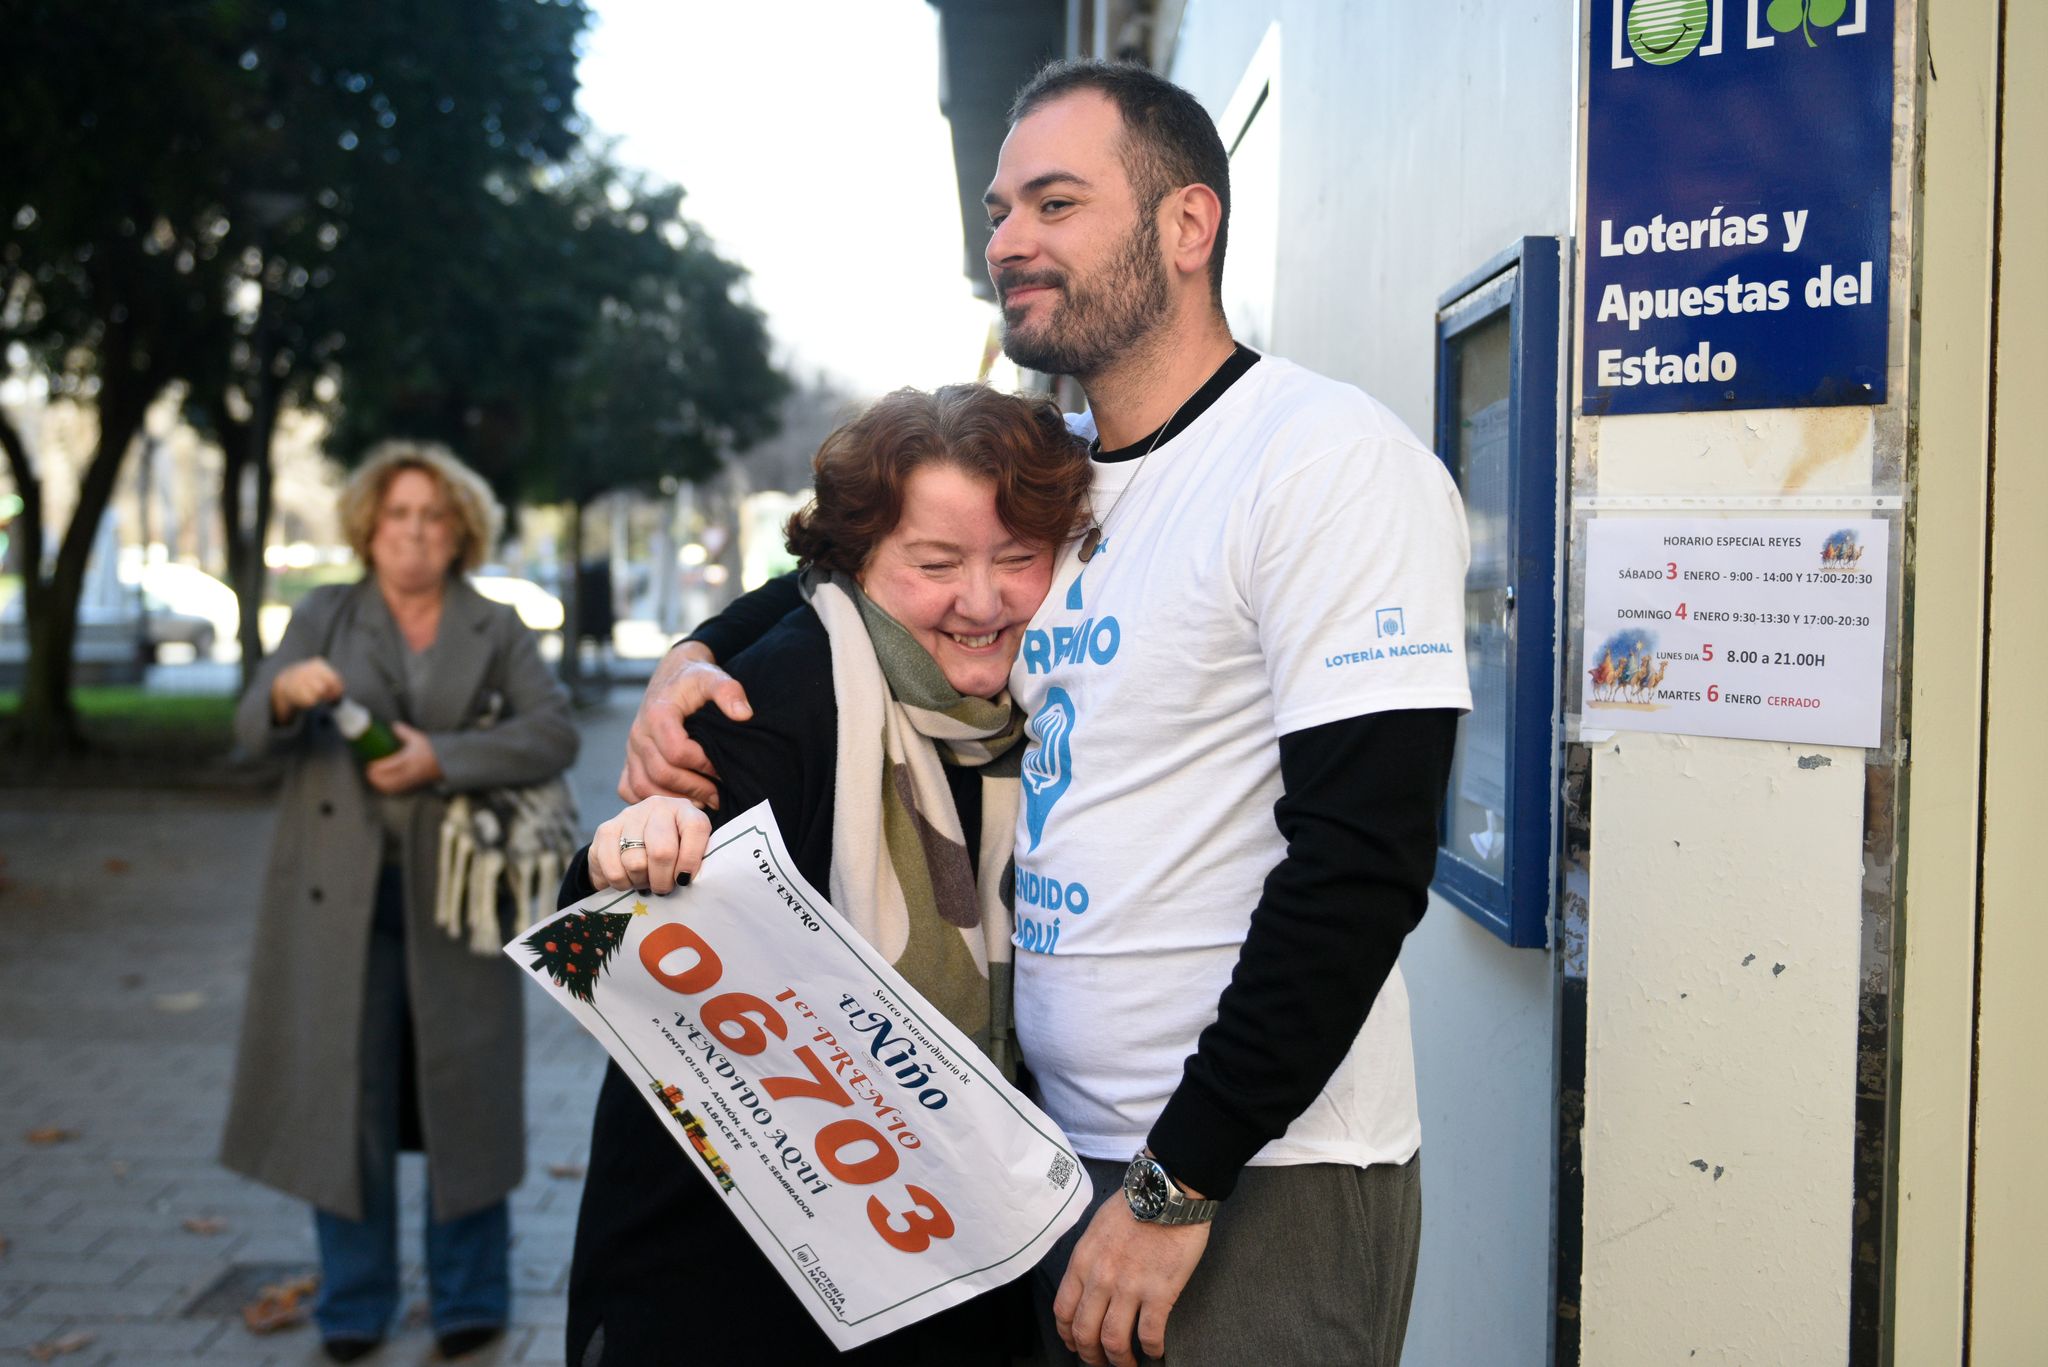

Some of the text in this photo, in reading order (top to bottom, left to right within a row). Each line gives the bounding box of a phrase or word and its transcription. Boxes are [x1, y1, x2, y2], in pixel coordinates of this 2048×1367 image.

[1600, 206, 1809, 257] Loterías y
[1596, 260, 1873, 331] Apuestas del
[1597, 341, 1737, 387] Estado
[1663, 536, 1802, 548] HORARIO ESPECIAL REYES
[1618, 568, 1663, 580] SÁBADO
[1666, 562, 1678, 580] 3
[1684, 570, 1720, 581] ENERO
[1729, 571, 1753, 582] 9:00
[1763, 572, 1793, 583] 14:00
[1796, 573, 1803, 583] Y
[1806, 573, 1873, 585] 17:00-20:30
[1617, 602, 1870, 627] DOMINGO 4 ENERO 9:30-13:30 Y 17:00-20:30
[1016, 616, 1121, 674] REMIO
[1325, 643, 1453, 668] LOTERÍA NACIONAL
[1656, 643, 1826, 667] LUNES DIA 5 8.00 a 21.00H
[1657, 684, 1820, 709] MARTES 6 ENERO CERRADO
[753, 849, 820, 932] 6 DE ENERO
[872, 989, 971, 1085] Sorteo Extraordinario de
[638, 922, 956, 1254] 06703
[775, 986, 922, 1150] 1er PREMIO
[652, 1017, 660, 1028] P.
[661, 1027, 686, 1056] VENTA
[711, 1091, 740, 1128] ADMÓN.
[750, 1141, 758, 1149] 8
[759, 1154, 770, 1166] EL
[769, 1166, 815, 1219] SEMBRADOR
[674, 1011, 833, 1195] VENDIDO AQUÍ
[700, 1100, 743, 1151] ALBACETE
[807, 1269, 846, 1317] NACIONAL
[815, 1265, 847, 1304] LOTERÍA
